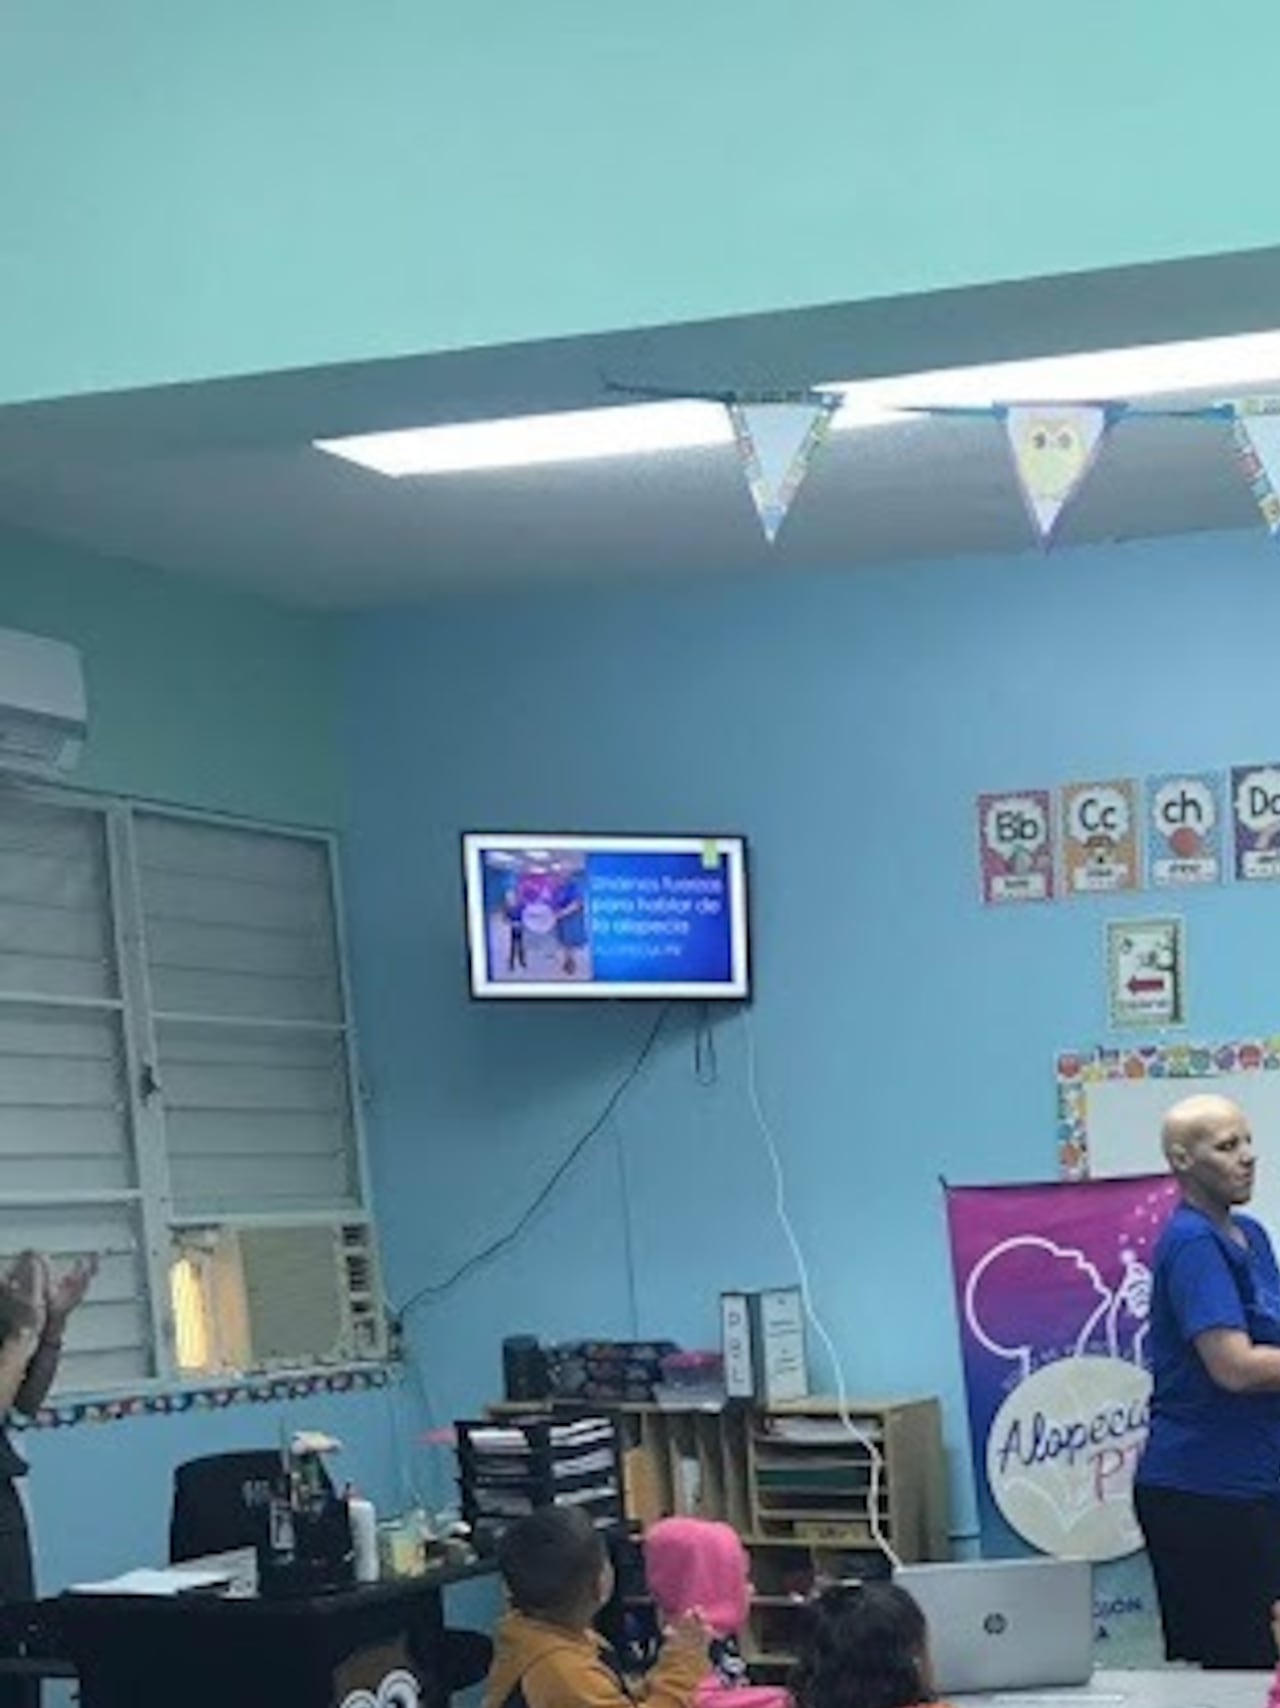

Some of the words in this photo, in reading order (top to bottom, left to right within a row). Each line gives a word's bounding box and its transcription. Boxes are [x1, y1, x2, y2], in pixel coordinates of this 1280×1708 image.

[1079, 797, 1117, 831] Cc
[1163, 790, 1202, 824] ch
[996, 809, 1039, 842] Bb
